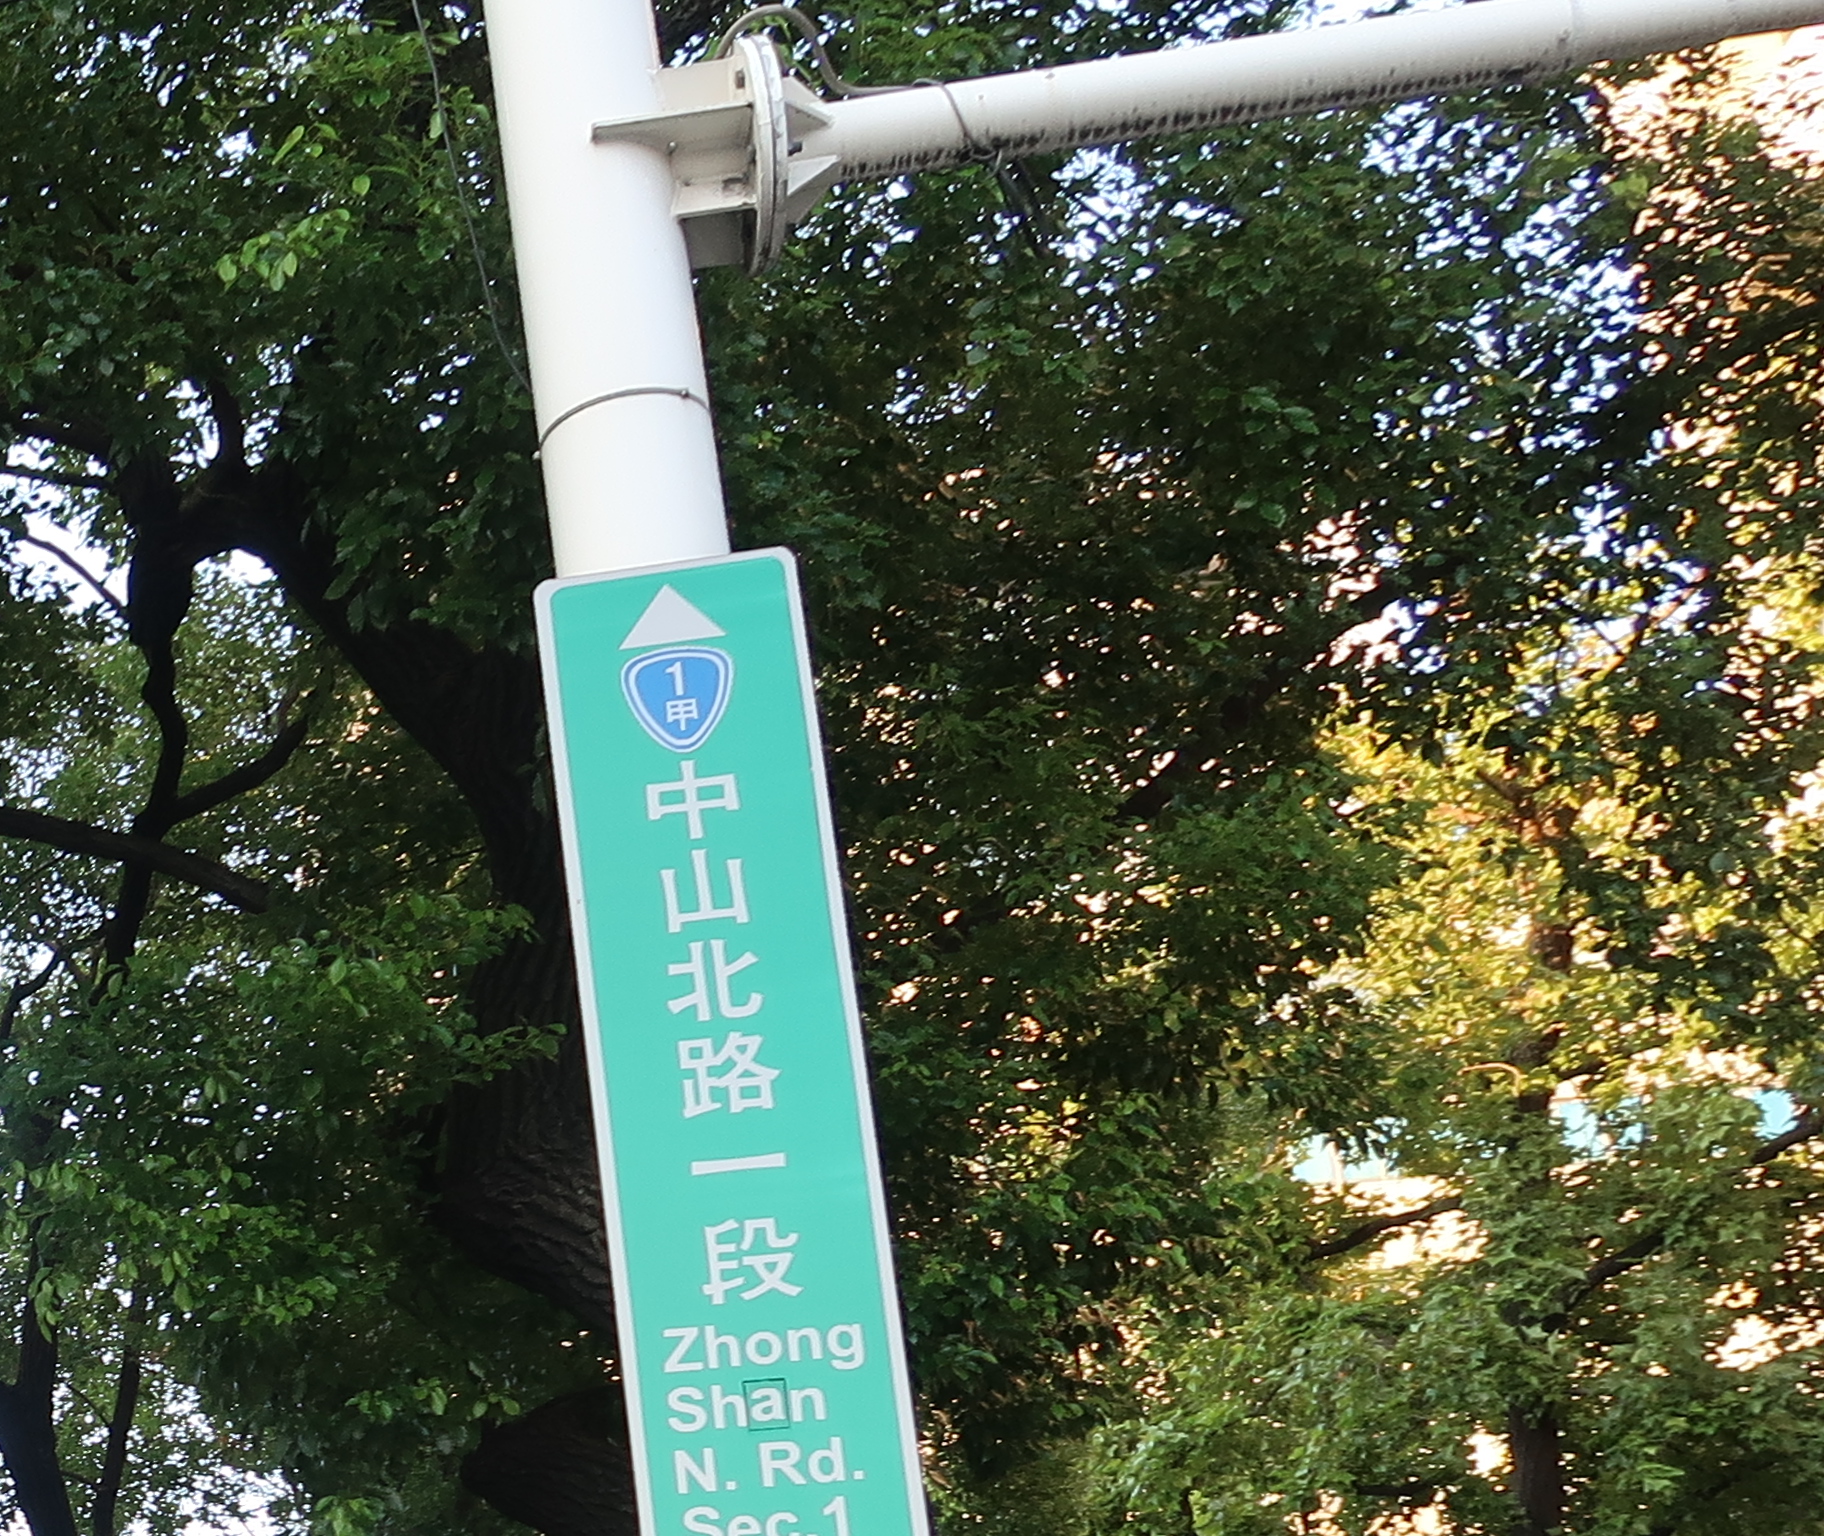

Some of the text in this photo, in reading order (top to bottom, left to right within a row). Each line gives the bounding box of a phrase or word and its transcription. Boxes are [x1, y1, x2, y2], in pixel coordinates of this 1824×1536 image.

[665, 661, 685, 696] 1
[666, 697, 698, 731] 甲
[645, 760, 805, 1305] 中山北路一段
[662, 1322, 866, 1373] Zhong
[666, 1384, 827, 1433] Shan
[673, 1437, 866, 1494] N. Rd.
